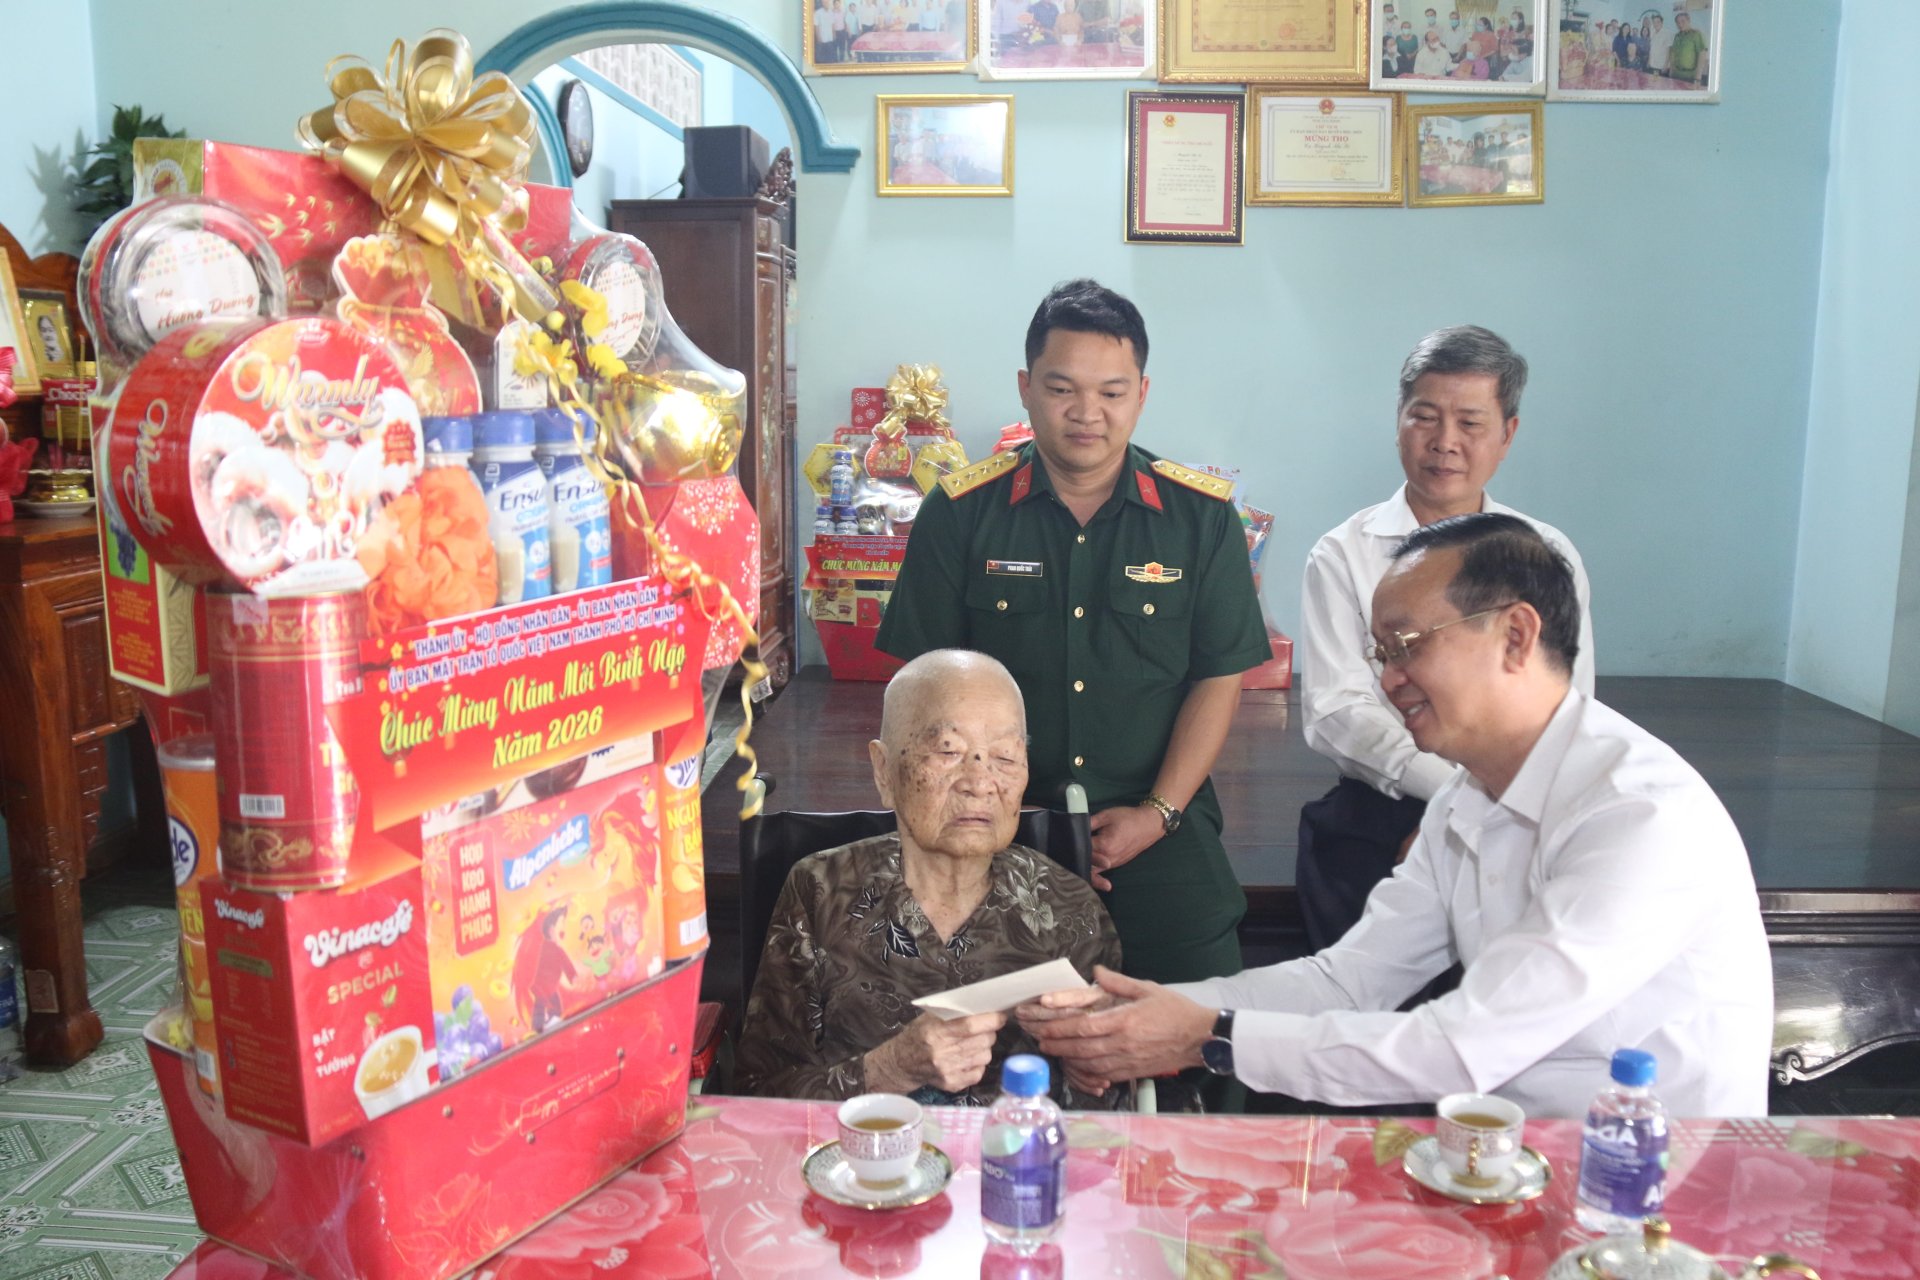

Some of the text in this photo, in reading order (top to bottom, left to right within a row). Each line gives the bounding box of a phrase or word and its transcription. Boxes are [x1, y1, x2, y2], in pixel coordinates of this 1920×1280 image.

[390, 604, 677, 692] ỦY BAN MẶT TRẬN TỔ QUỐC VIỆT NAM THÀNH PHỐ HỒ CHÍ MINH
[414, 634, 451, 659] THÀNH
[452, 626, 467, 651] ỦY
[474, 622, 492, 647] HỘI
[494, 615, 520, 640] ĐỒNG
[522, 608, 549, 633] NHÂN
[551, 604, 571, 625] DÂN
[578, 598, 590, 620] ỦY
[592, 597, 612, 618] BAN
[612, 590, 638, 613] NHÂN
[638, 586, 658, 608] DÂN
[380, 709, 434, 755] Chúc
[437, 693, 499, 730] Mừng
[503, 675, 556, 715] Năm
[560, 660, 596, 700] Mới
[599, 644, 644, 687] Bính
[648, 637, 686, 676] Ngọ
[492, 705, 603, 769] Năm 2026
[509, 820, 583, 889] Alpenliebe
[304, 899, 413, 968] Vinacafé
[327, 961, 404, 1005] SPECIAL
[312, 1028, 335, 1047] BẬT
[315, 1047, 324, 1062] Ý
[316, 1053, 355, 1078] TƯỞNG
